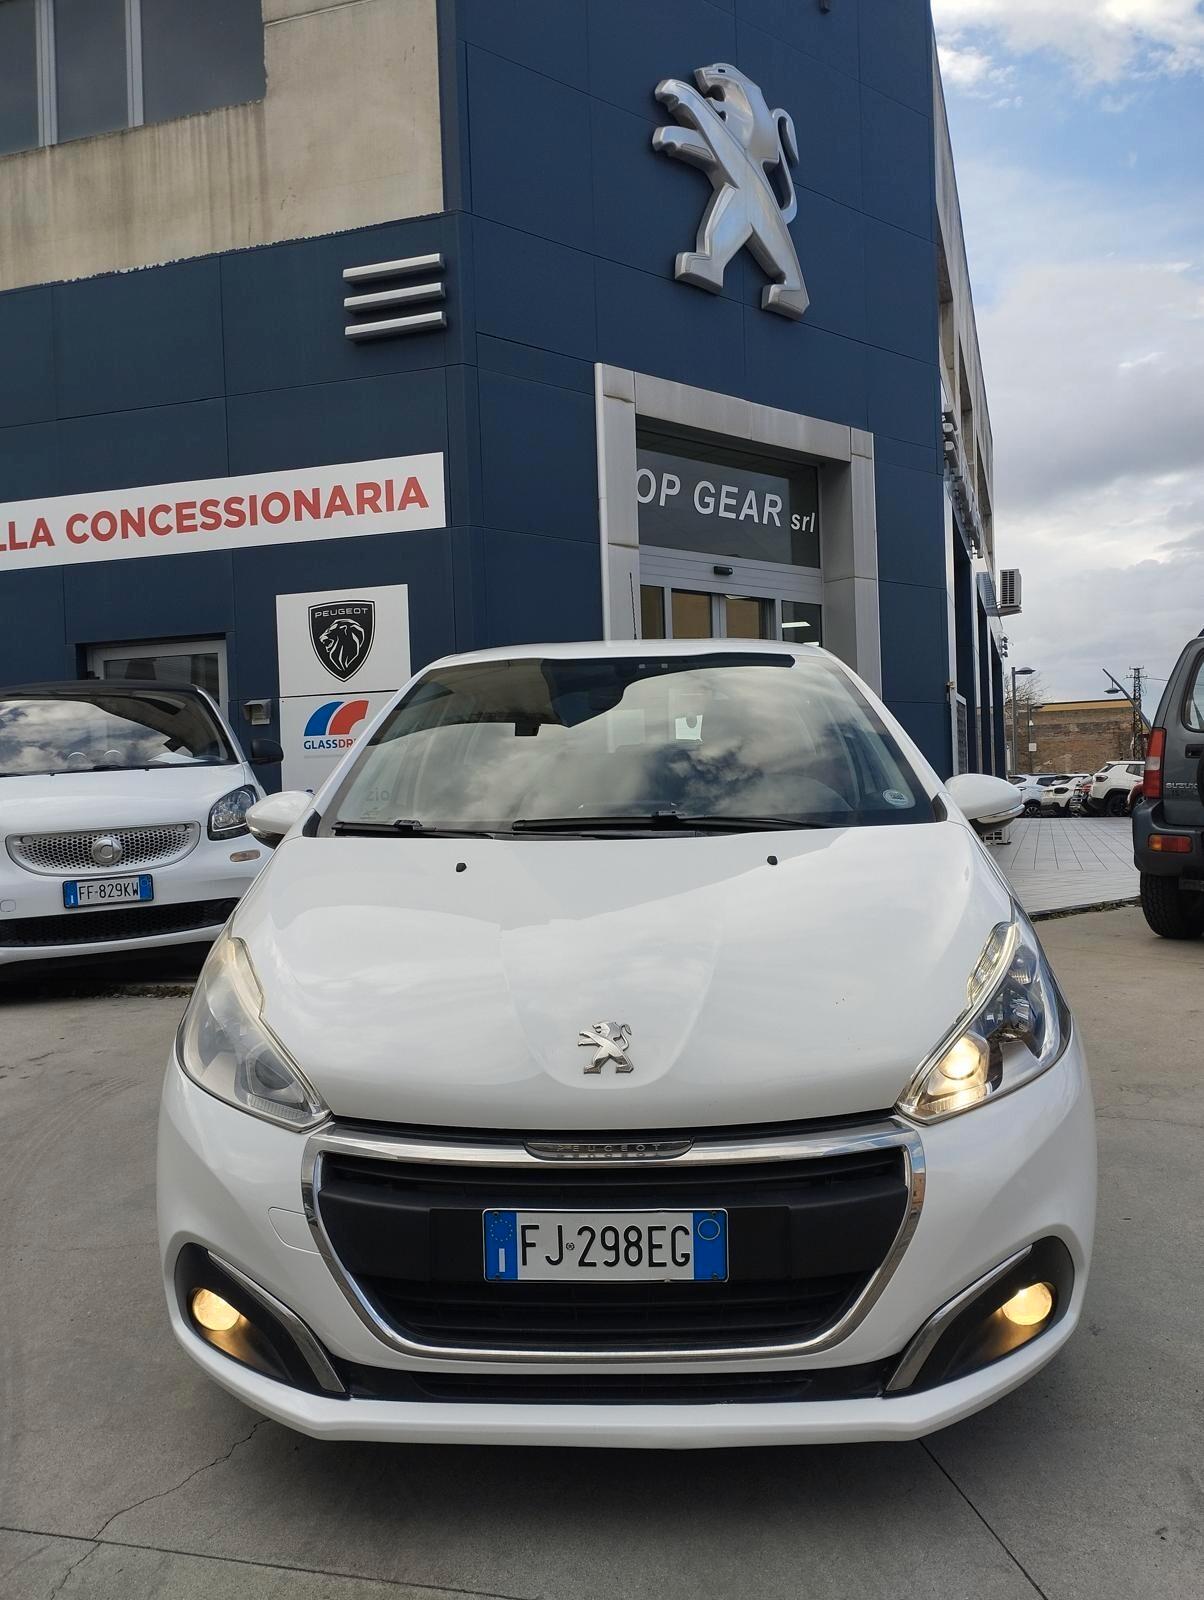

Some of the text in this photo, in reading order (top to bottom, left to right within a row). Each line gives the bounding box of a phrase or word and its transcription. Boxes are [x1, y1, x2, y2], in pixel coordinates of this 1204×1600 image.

[66, 476, 430, 545] CONCESSIONARIA
[693, 480, 783, 527] GEAR
[790, 512, 816, 533] srl
[314, 607, 369, 619] PEUGEOT
[556, 1143, 661, 1152] PEUGEOT
